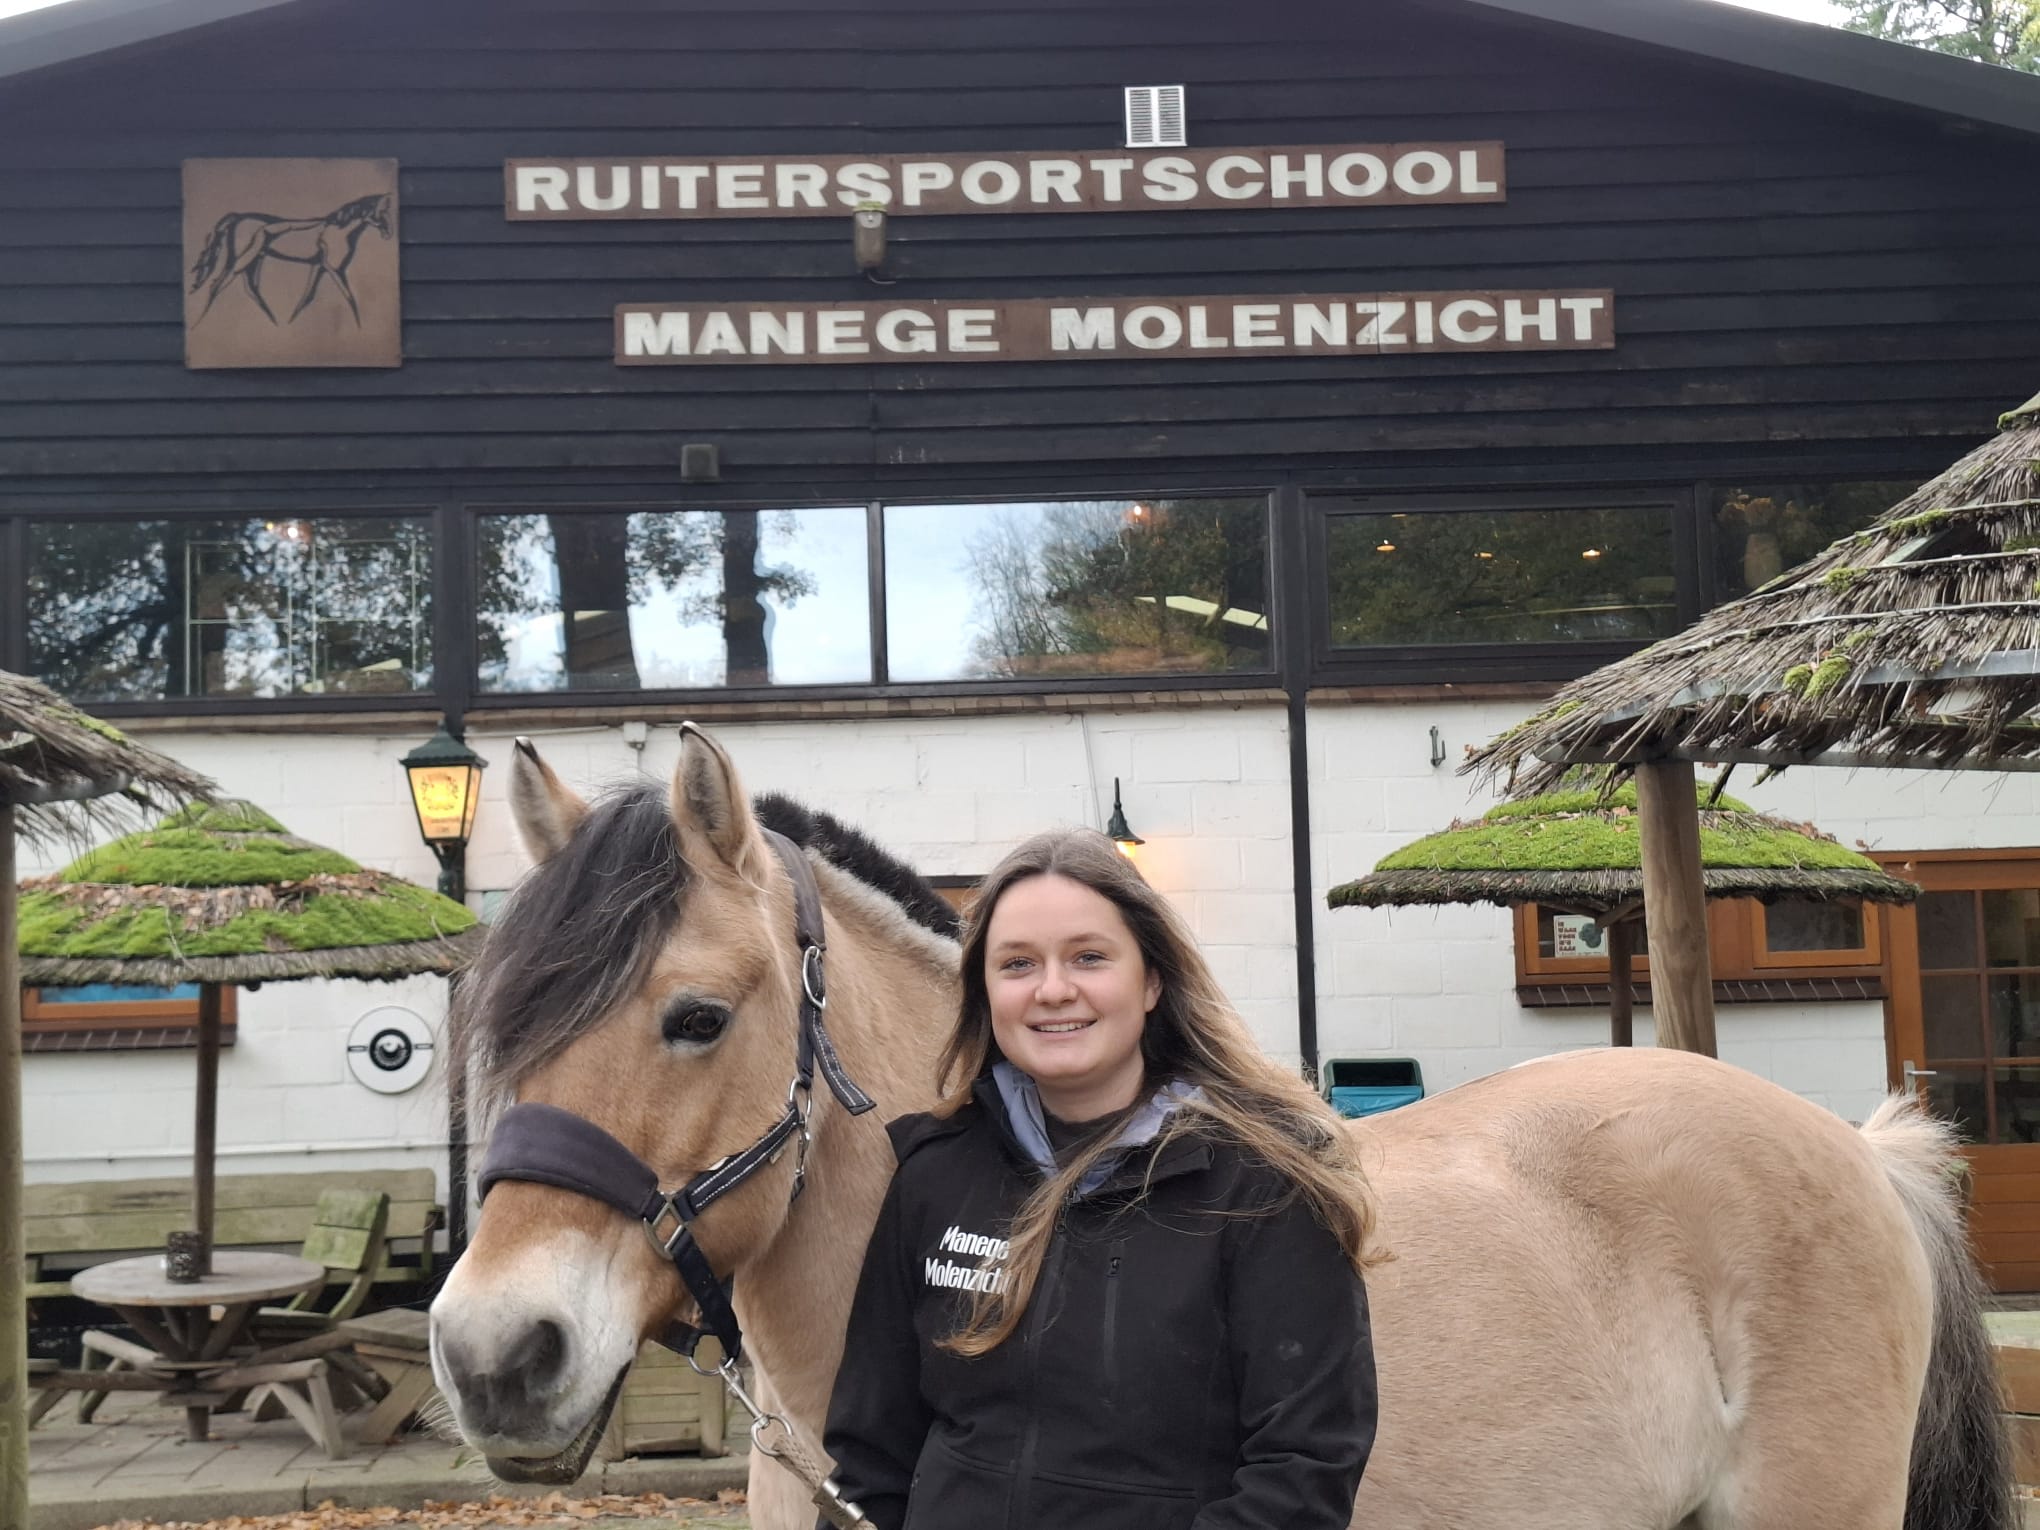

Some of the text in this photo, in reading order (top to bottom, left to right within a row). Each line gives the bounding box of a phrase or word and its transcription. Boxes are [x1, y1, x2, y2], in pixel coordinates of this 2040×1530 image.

[515, 150, 1498, 212] RUITERSPORTSCHOOL
[623, 297, 1604, 356] MANEGE MOLENZICHT
[939, 1225, 1010, 1266] Manege
